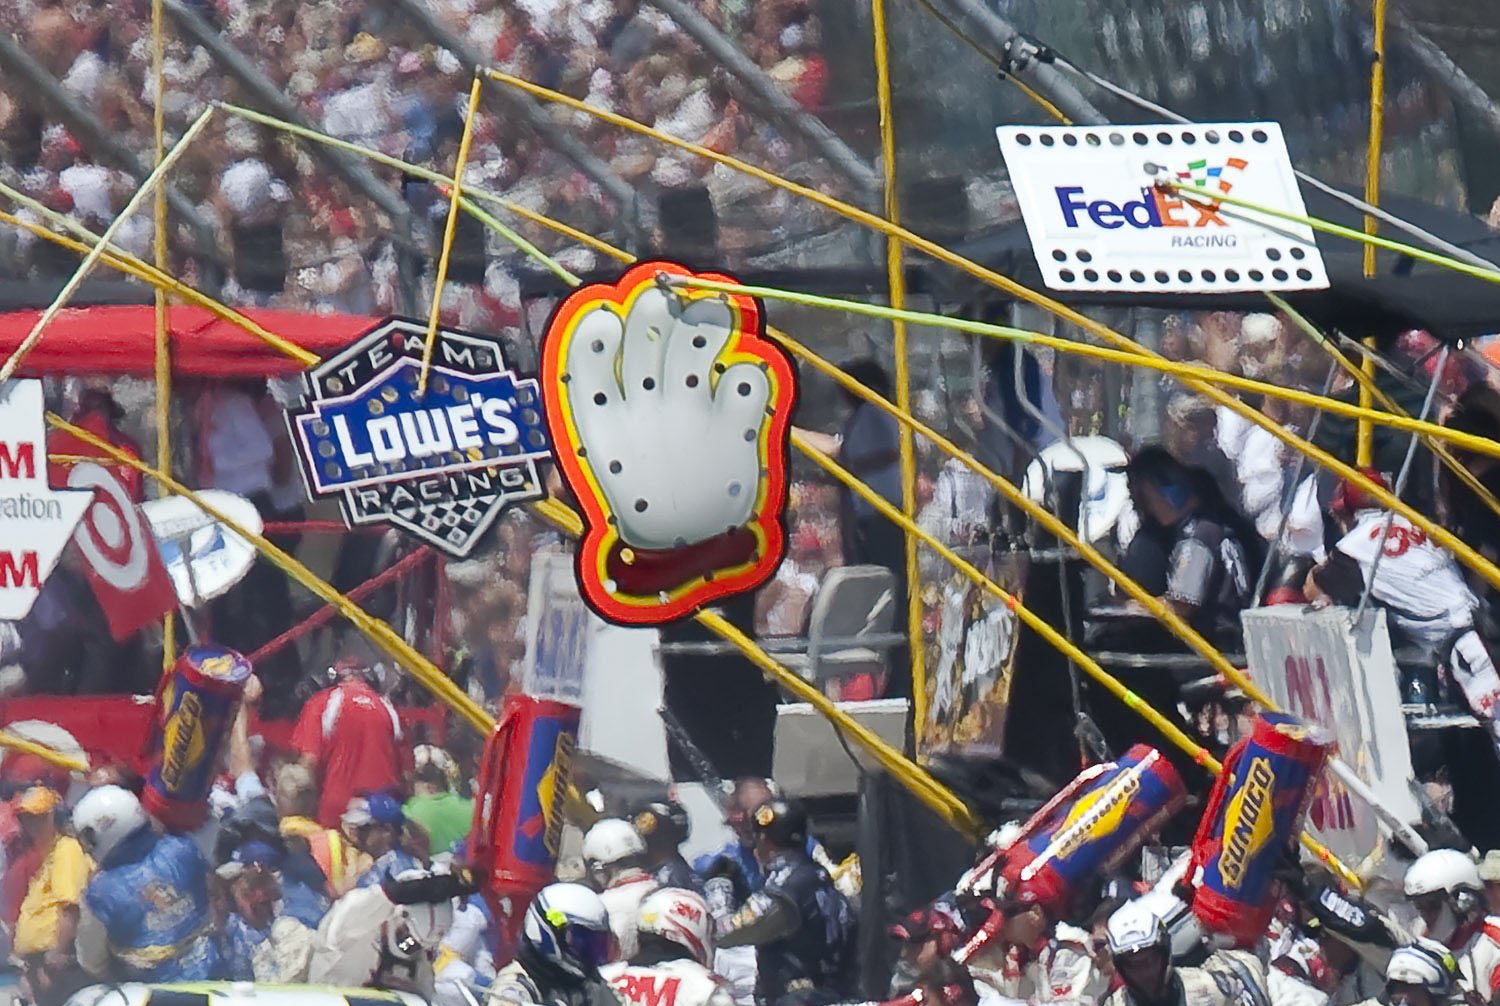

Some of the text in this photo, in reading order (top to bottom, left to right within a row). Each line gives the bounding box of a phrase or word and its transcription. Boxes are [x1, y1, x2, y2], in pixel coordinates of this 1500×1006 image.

[1054, 184, 1229, 229] FedEx
[1170, 234, 1237, 249] RACING
[338, 335, 476, 385] TEAM
[332, 392, 519, 468] LOWE'S
[359, 466, 525, 509] RACING
[1222, 764, 1273, 878] SUNOCO
